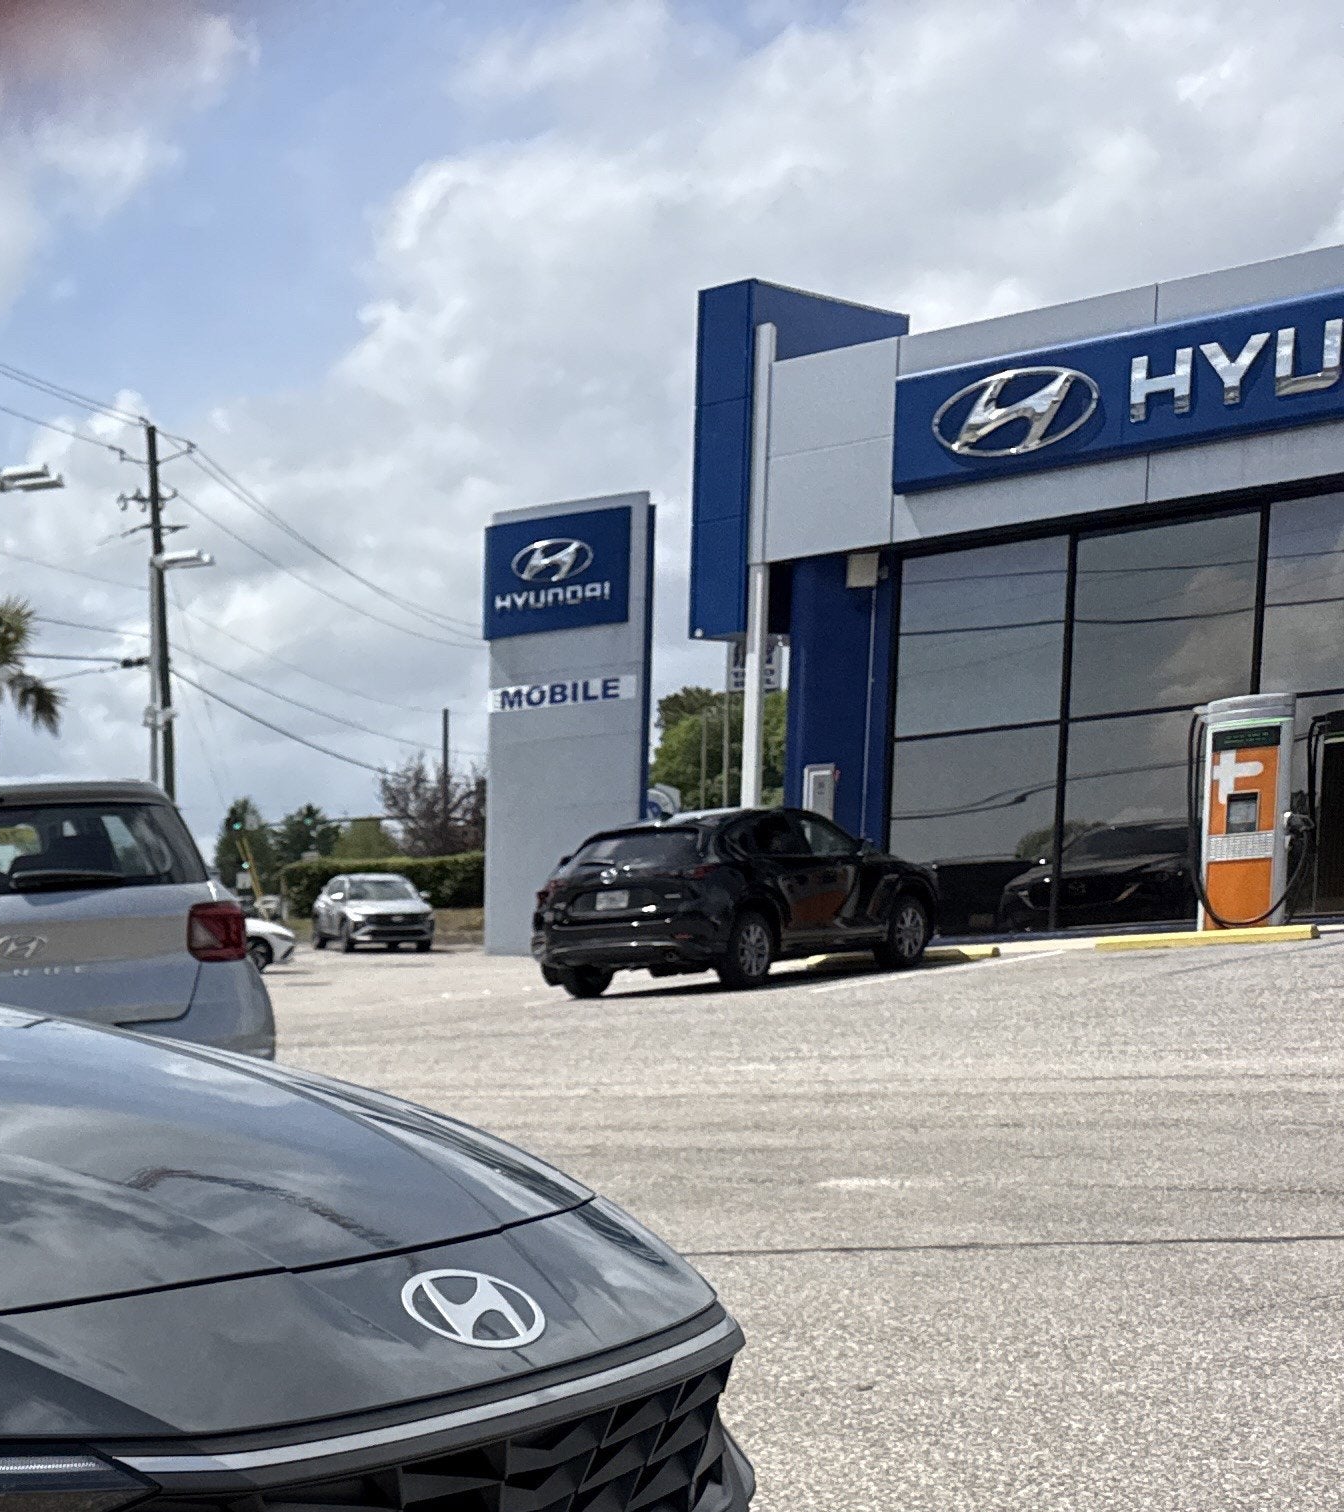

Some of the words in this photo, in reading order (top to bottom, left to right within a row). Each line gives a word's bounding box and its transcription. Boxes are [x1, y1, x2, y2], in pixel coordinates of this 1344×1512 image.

[1129, 318, 1344, 423] HYU
[494, 581, 611, 611] HYUNDAI
[499, 678, 620, 709] MOBILE
